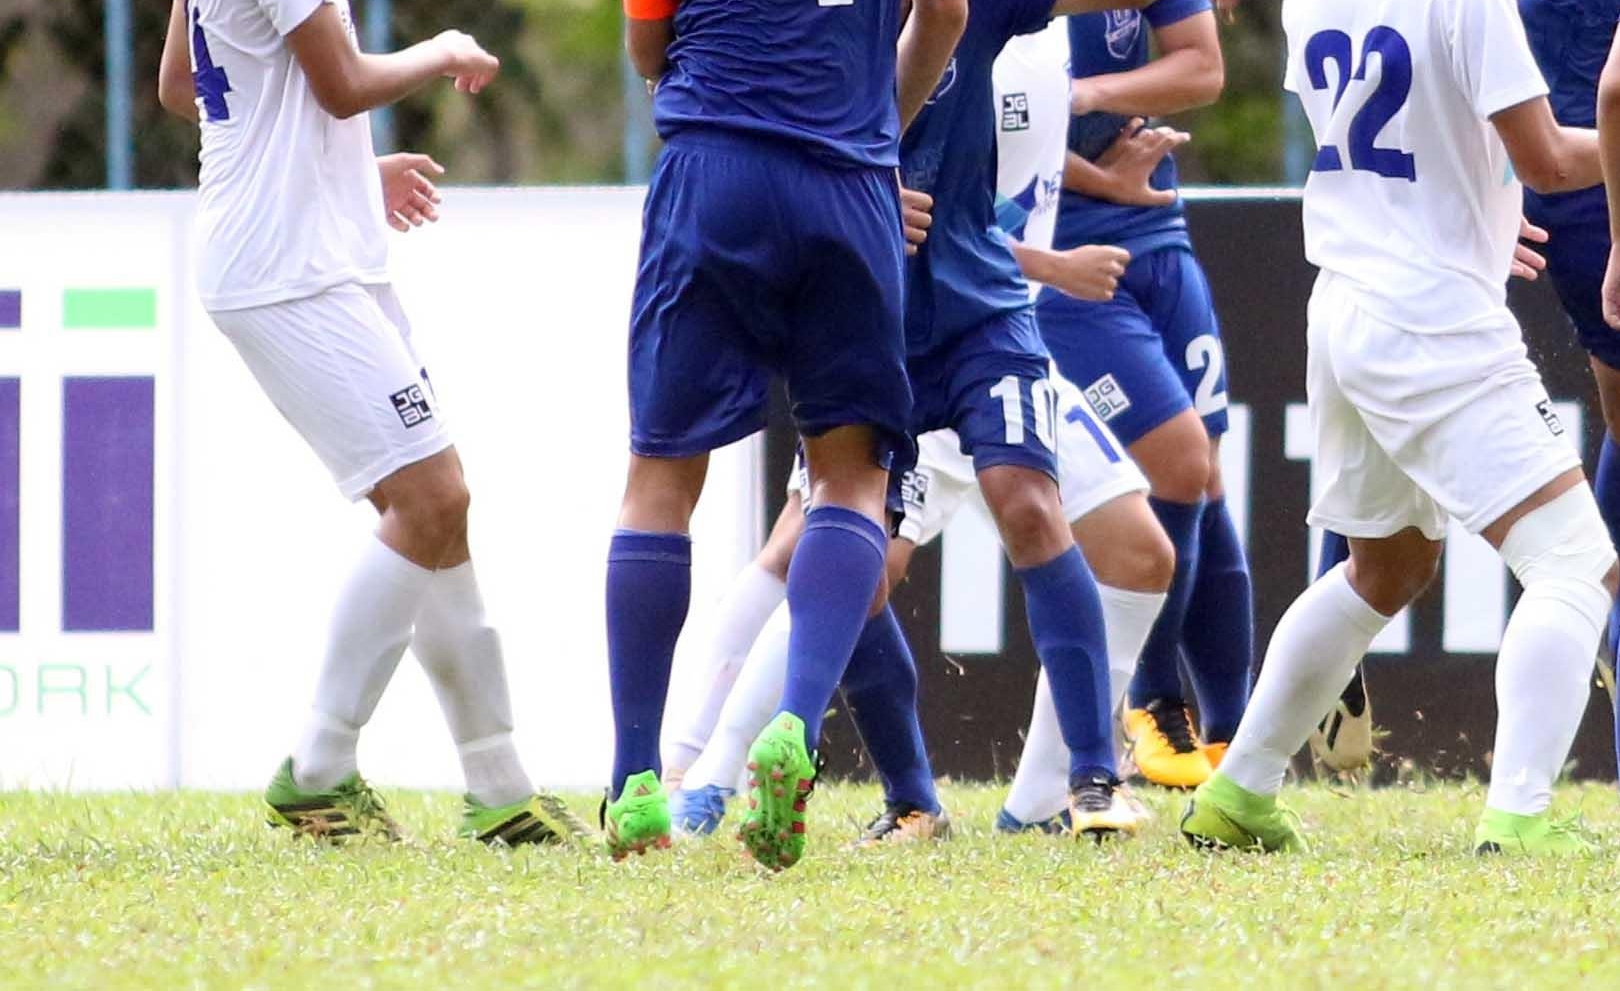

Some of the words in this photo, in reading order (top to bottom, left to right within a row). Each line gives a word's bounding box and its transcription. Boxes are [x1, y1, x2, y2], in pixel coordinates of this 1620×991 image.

[1304, 24, 1416, 183] 22
[990, 375, 1058, 454] 10
[1185, 334, 1229, 418] 2
